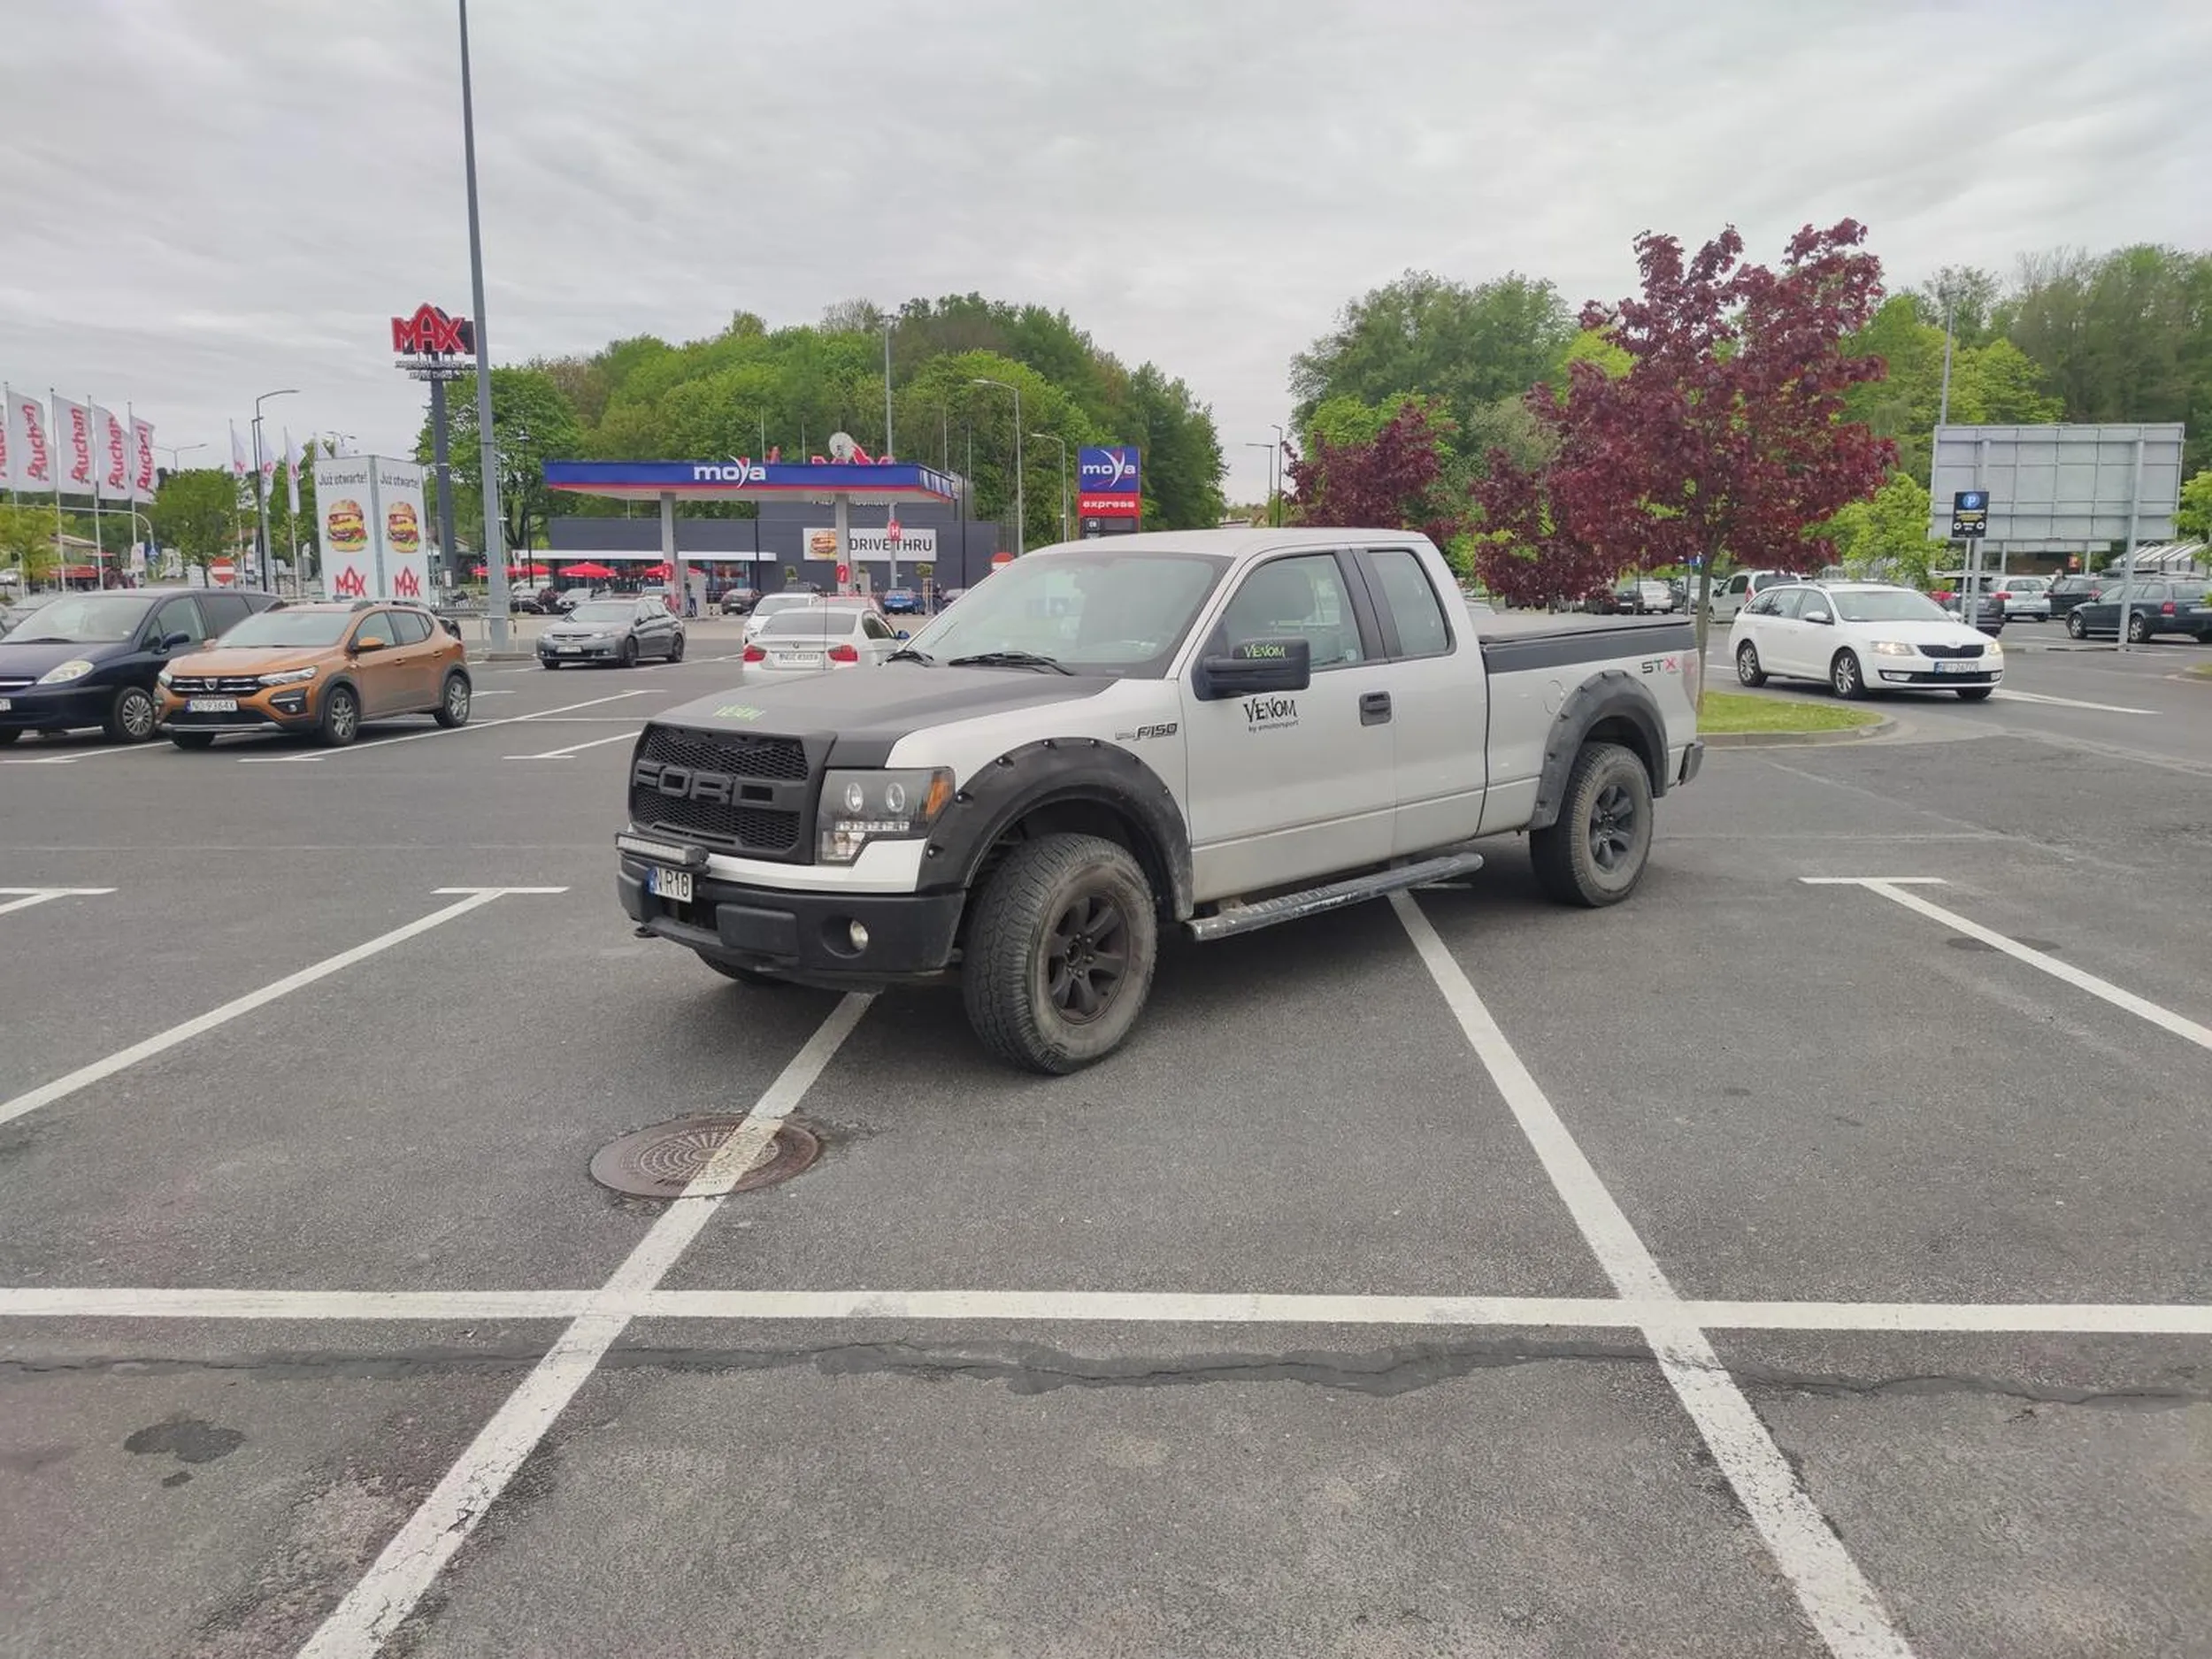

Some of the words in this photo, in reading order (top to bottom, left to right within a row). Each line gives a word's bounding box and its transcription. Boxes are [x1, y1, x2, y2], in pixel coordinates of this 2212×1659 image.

[391, 302, 465, 352] MAX
[70, 408, 91, 484] Auchan
[694, 454, 766, 488] moya
[1082, 449, 1137, 488] moya
[1082, 501, 1135, 510] express
[849, 539, 890, 550] DRIVE
[895, 539, 933, 551] THRU
[335, 565, 366, 596] MAX
[395, 565, 420, 596] MAX
[1244, 644, 1286, 657] VENOM
[1641, 657, 1677, 673] STX
[1243, 697, 1297, 723] VENOM
[633, 759, 780, 809] FORD
